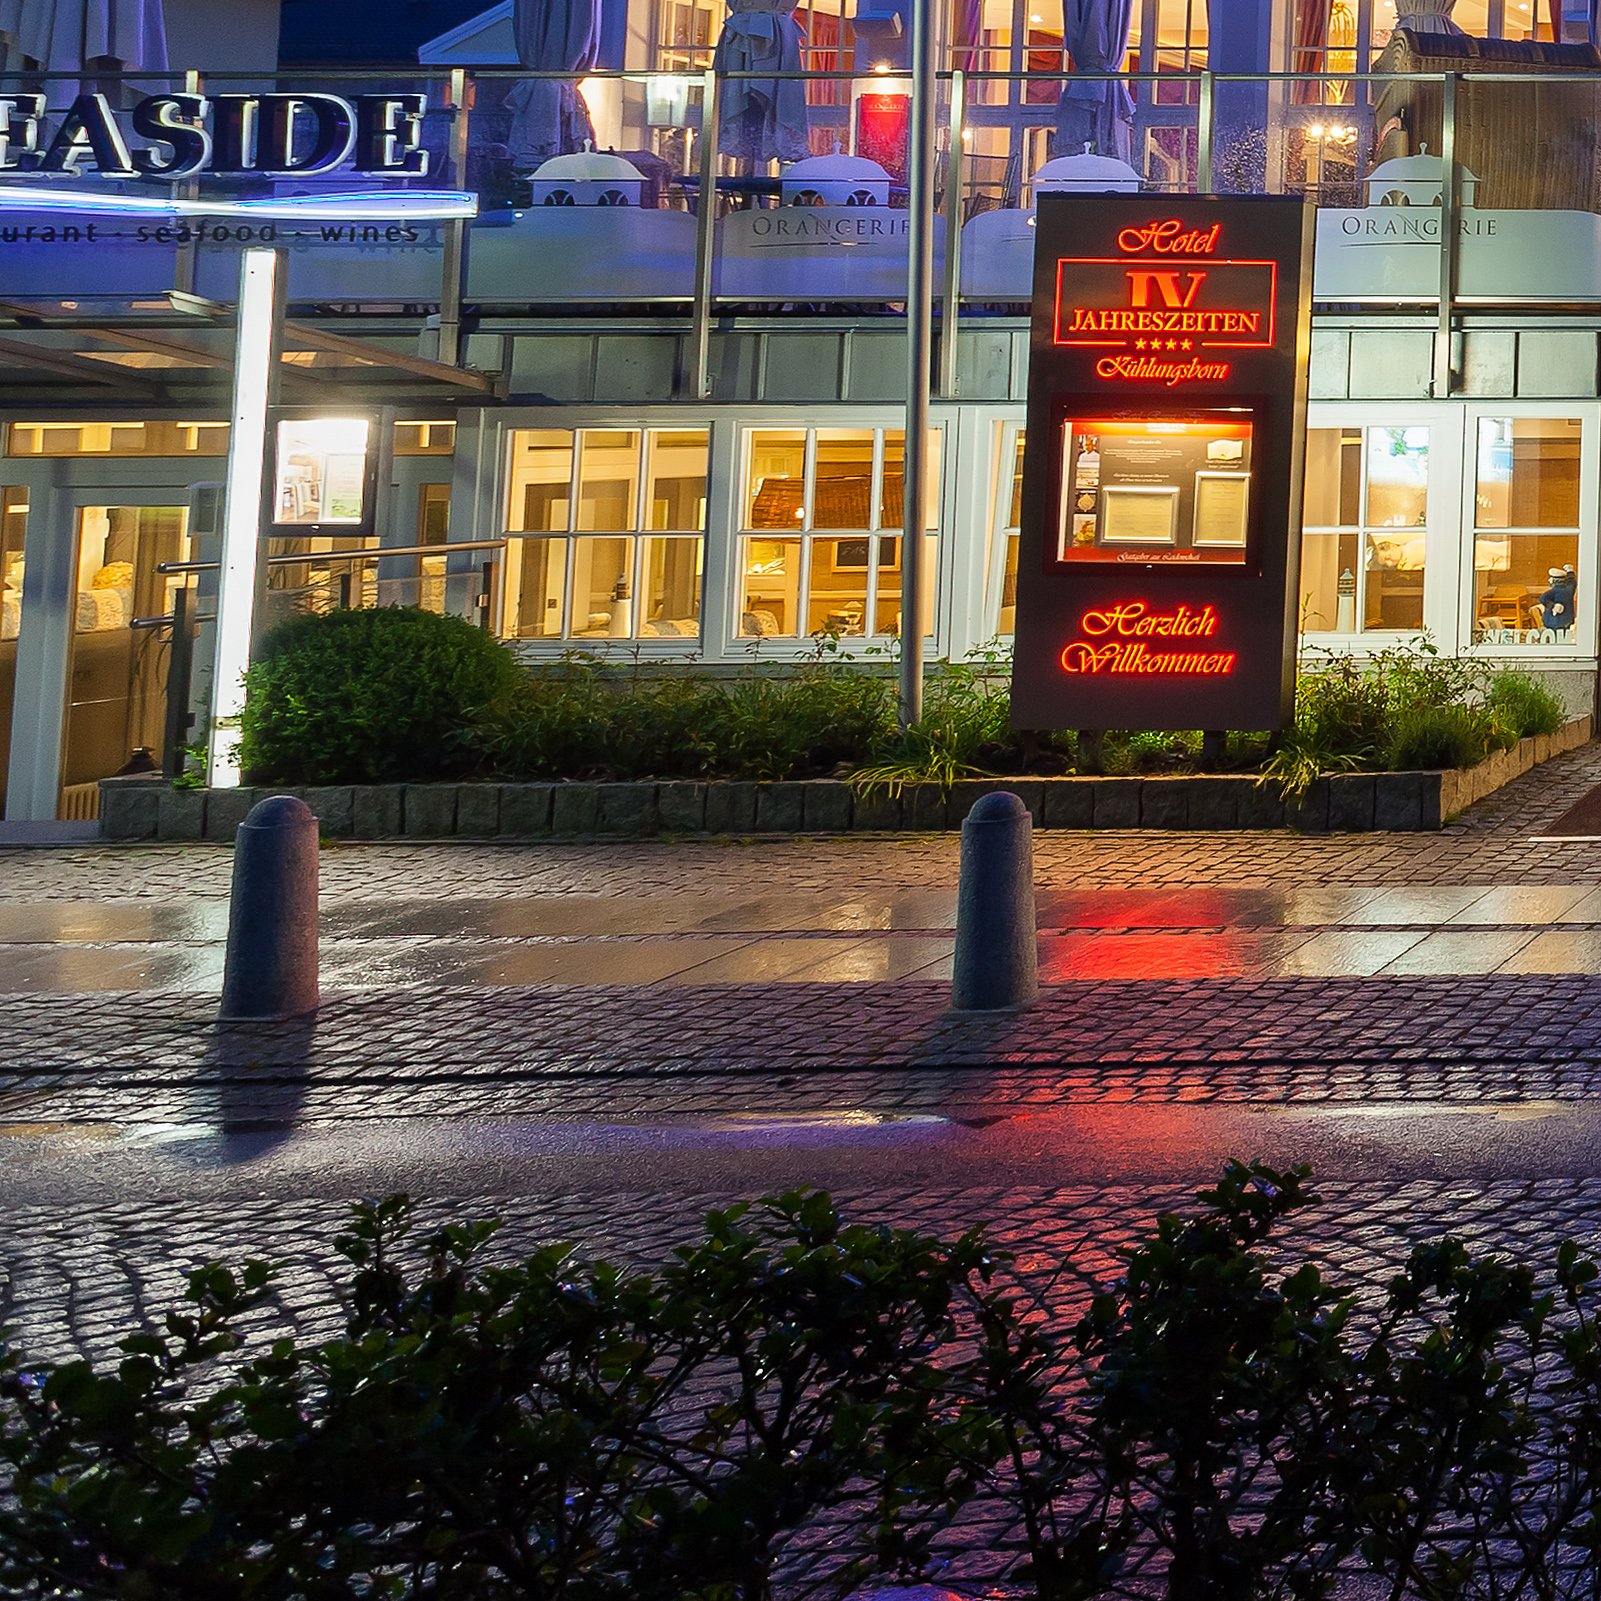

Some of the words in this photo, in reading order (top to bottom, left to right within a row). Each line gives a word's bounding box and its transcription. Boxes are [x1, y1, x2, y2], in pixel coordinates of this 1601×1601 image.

[137, 219, 277, 244] seafood
[320, 220, 419, 243] wines
[1118, 220, 1221, 253] Hotel
[1342, 213, 1497, 241] ORANGRIE
[1126, 270, 1207, 308] IV
[1068, 309, 1260, 332] JAHRESZEITEN
[1097, 356, 1230, 386] Kühlungsborn
[1082, 602, 1216, 636] Herzlich
[1061, 642, 1235, 673] Willkommen
